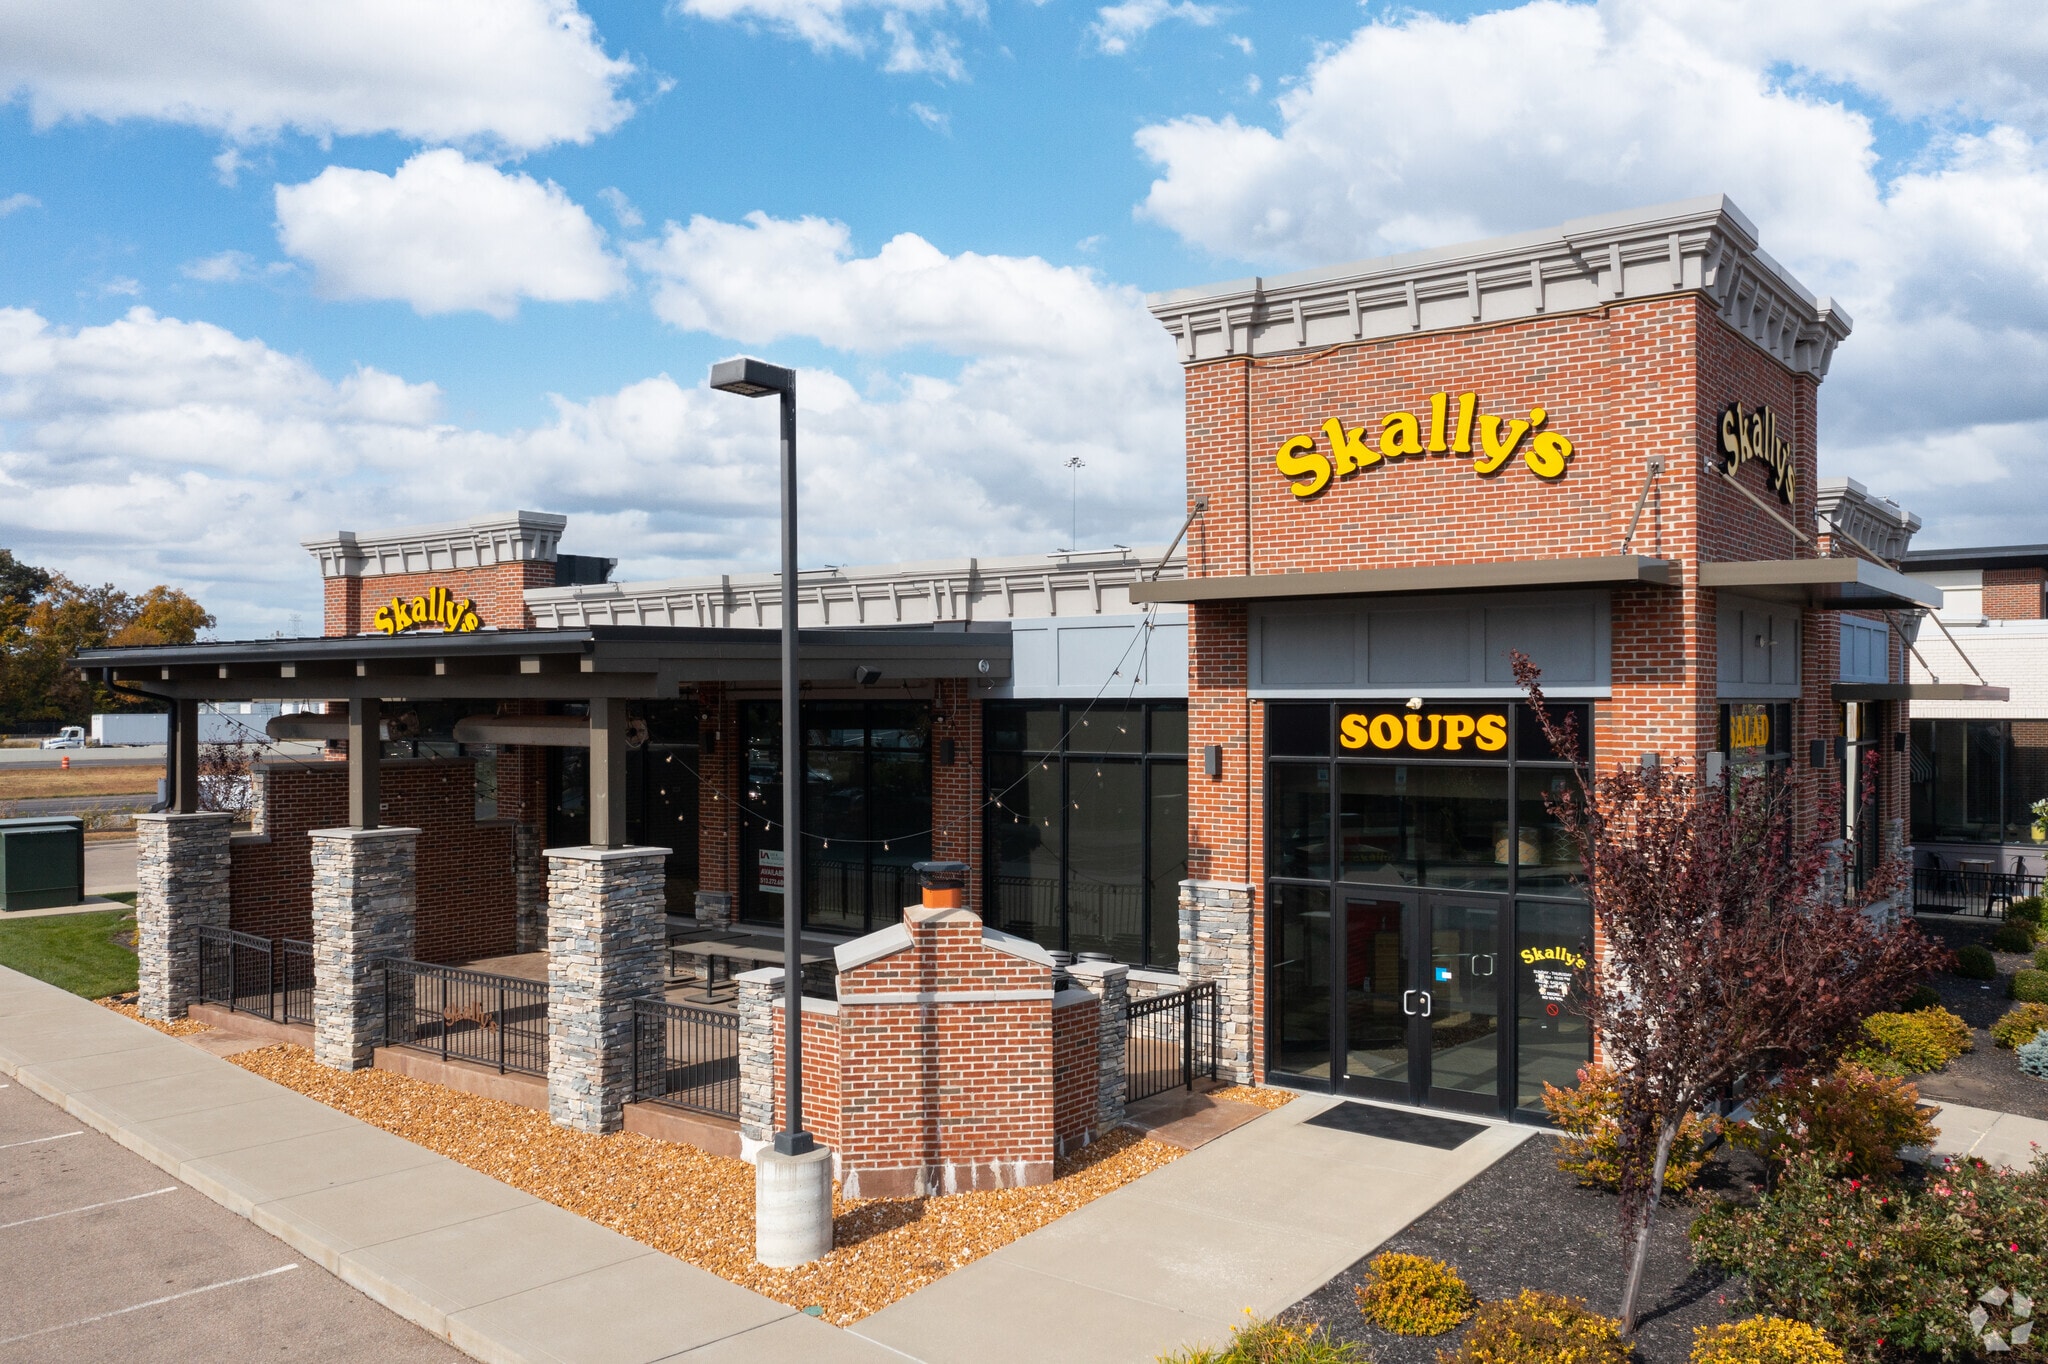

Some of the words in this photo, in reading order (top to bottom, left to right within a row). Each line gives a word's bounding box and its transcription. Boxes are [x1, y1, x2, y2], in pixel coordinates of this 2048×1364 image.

[1275, 391, 1573, 497] Skally's
[1721, 401, 1796, 505] Skally's
[374, 586, 479, 636] Skally's
[1339, 713, 1507, 751] SOUPS
[760, 868, 784, 877] AVAILAB
[1520, 946, 1586, 969] Skally's
